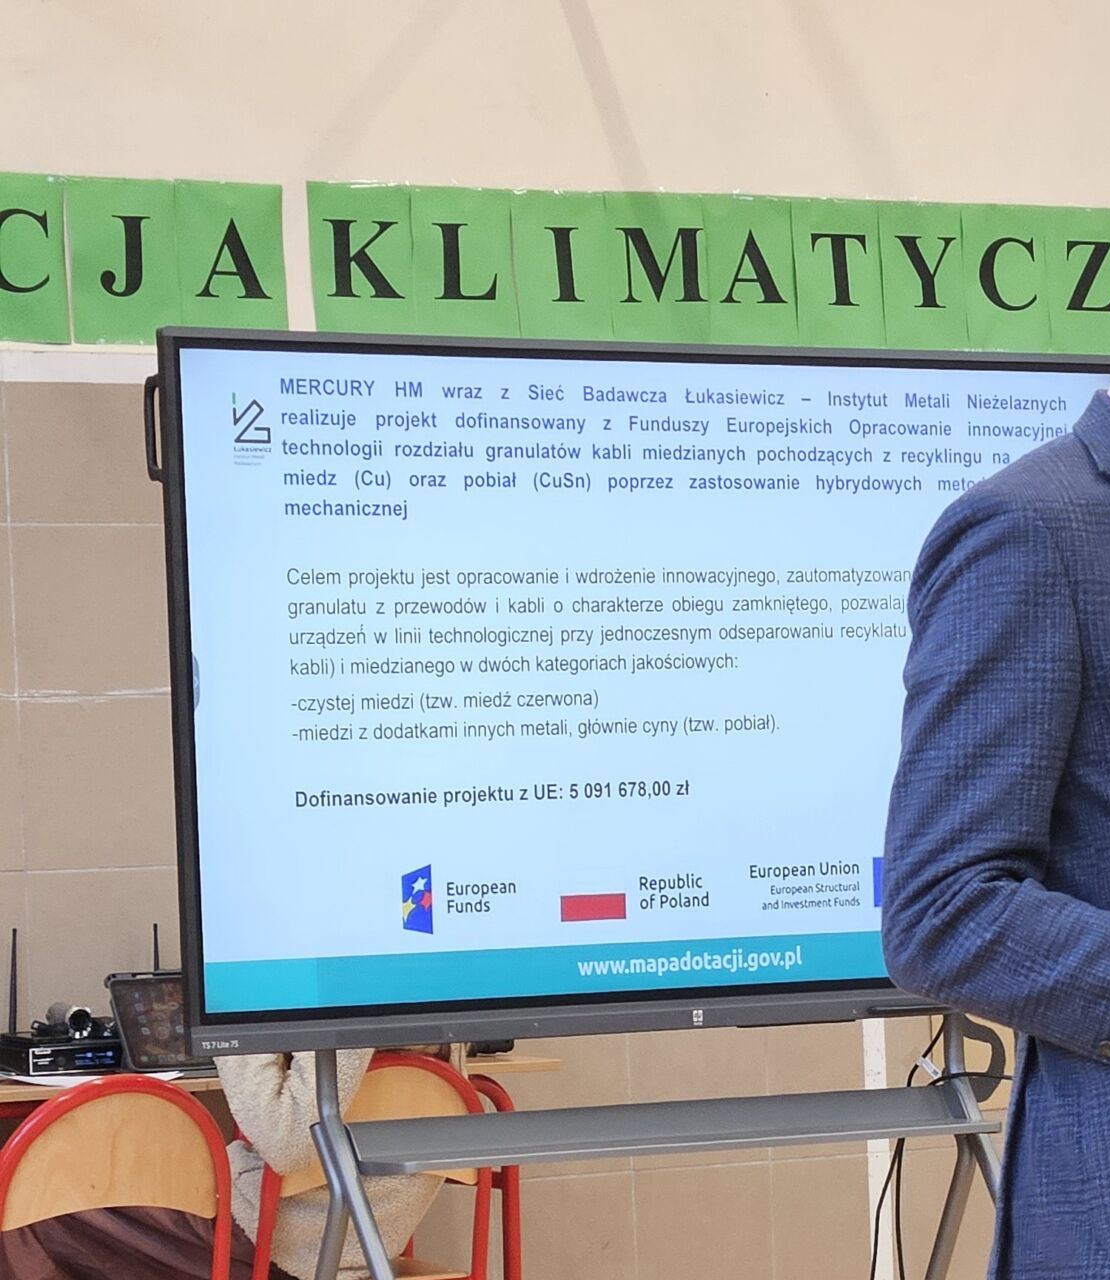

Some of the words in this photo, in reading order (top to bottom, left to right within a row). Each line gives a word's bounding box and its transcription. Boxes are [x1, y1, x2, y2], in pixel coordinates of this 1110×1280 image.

[279, 378, 376, 398] MERCURY
[394, 381, 423, 399] HM
[442, 386, 483, 400] wraz
[499, 388, 511, 401] z
[527, 384, 566, 405] Sieć
[582, 386, 668, 405] Badawcza
[683, 388, 786, 409] Łukasiewicz
[828, 391, 888, 411] Instytut
[904, 393, 951, 409] Metali
[966, 394, 1067, 416] Nieżelaznych
[280, 408, 357, 431] realizuje
[375, 411, 438, 433] projekt
[454, 412, 587, 436] dofinansowany
[602, 419, 613, 431] z
[628, 416, 710, 438] Funduszy
[726, 417, 833, 440] Europejskich
[849, 419, 952, 440] Opracowanie
[280, 438, 383, 461] technologii
[394, 441, 475, 459] rozdziału
[485, 442, 582, 463] granulatów
[591, 443, 632, 461] kabli
[642, 444, 747, 466] miedzianych
[756, 446, 873, 467] pochodzących
[882, 451, 892, 463] z
[900, 448, 983, 469] recyklingu
[992, 453, 1009, 465] na
[283, 469, 337, 486] miedz
[354, 470, 392, 491] (Cu)
[408, 475, 447, 488] oraz
[463, 472, 517, 492] pobiał
[533, 472, 591, 493] (CuSn)
[607, 477, 674, 493] poprzez
[688, 475, 800, 490] zastosowanie
[815, 475, 922, 495] hybrydowych
[937, 476, 985, 492] meto
[285, 498, 407, 520] mechanicznej
[286, 568, 342, 586] Celem
[348, 568, 415, 590] projektu
[420, 568, 451, 590] jest
[456, 568, 560, 589] opracowanie
[574, 568, 656, 585] wdrożenie
[662, 567, 781, 588] innowacyjnego,
[287, 598, 367, 620] granulatu
[375, 602, 386, 615] z
[394, 597, 487, 619] przewodów
[508, 597, 545, 614] kabli
[553, 601, 564, 614] o
[571, 596, 664, 614] charakterze
[671, 596, 724, 616] obiegu
[731, 595, 833, 616] zamkniętego,
[289, 624, 367, 650] urządzeń
[373, 632, 388, 645] w
[394, 627, 422, 645] linii
[428, 626, 554, 648] technologicznej
[560, 630, 594, 647] przy
[599, 625, 712, 647] jednoczesnym
[719, 623, 833, 643] odseparowaniu
[841, 622, 907, 642] recyklatu
[289, 657, 339, 680] kabli)
[350, 657, 456, 679] miedzianego
[459, 660, 474, 673] w
[477, 656, 531, 674] dwóch
[535, 654, 627, 676] kategoriach
[630, 652, 739, 675] jakościowych:
[291, 694, 354, 716] -czystej
[361, 693, 414, 711] miedzi
[419, 693, 458, 714] (tzw.
[463, 691, 512, 709] miedź
[516, 690, 599, 710] czerwona)
[291, 723, 353, 742] -miedzi
[357, 727, 369, 741] z
[372, 721, 458, 740] dodatkami
[463, 720, 516, 742] innych
[520, 719, 573, 738] metali,
[577, 718, 638, 740] głównie
[642, 720, 679, 738] cyny
[683, 716, 719, 737] (tzw.
[724, 714, 781, 735] pobiał).
[295, 788, 438, 808] Dofinansowanie
[443, 786, 514, 808] projektu
[518, 789, 529, 801] z
[533, 784, 564, 801] UE:
[568, 783, 579, 800] 5
[583, 782, 612, 799] 091
[617, 780, 672, 800] 678,00
[676, 779, 689, 796] zł
[639, 873, 703, 893] Republic
[749, 864, 816, 881] European
[819, 860, 860, 876] Union
[446, 881, 517, 898] European
[640, 894, 656, 910] of
[659, 891, 710, 909] Poland
[770, 884, 814, 895] European
[815, 881, 860, 894] Structural
[446, 898, 491, 913] Funds
[762, 899, 779, 910] and
[781, 898, 832, 909] Investment
[834, 896, 861, 908] Funds
[577, 944, 802, 977] www.mapadotacji.gov.pl
